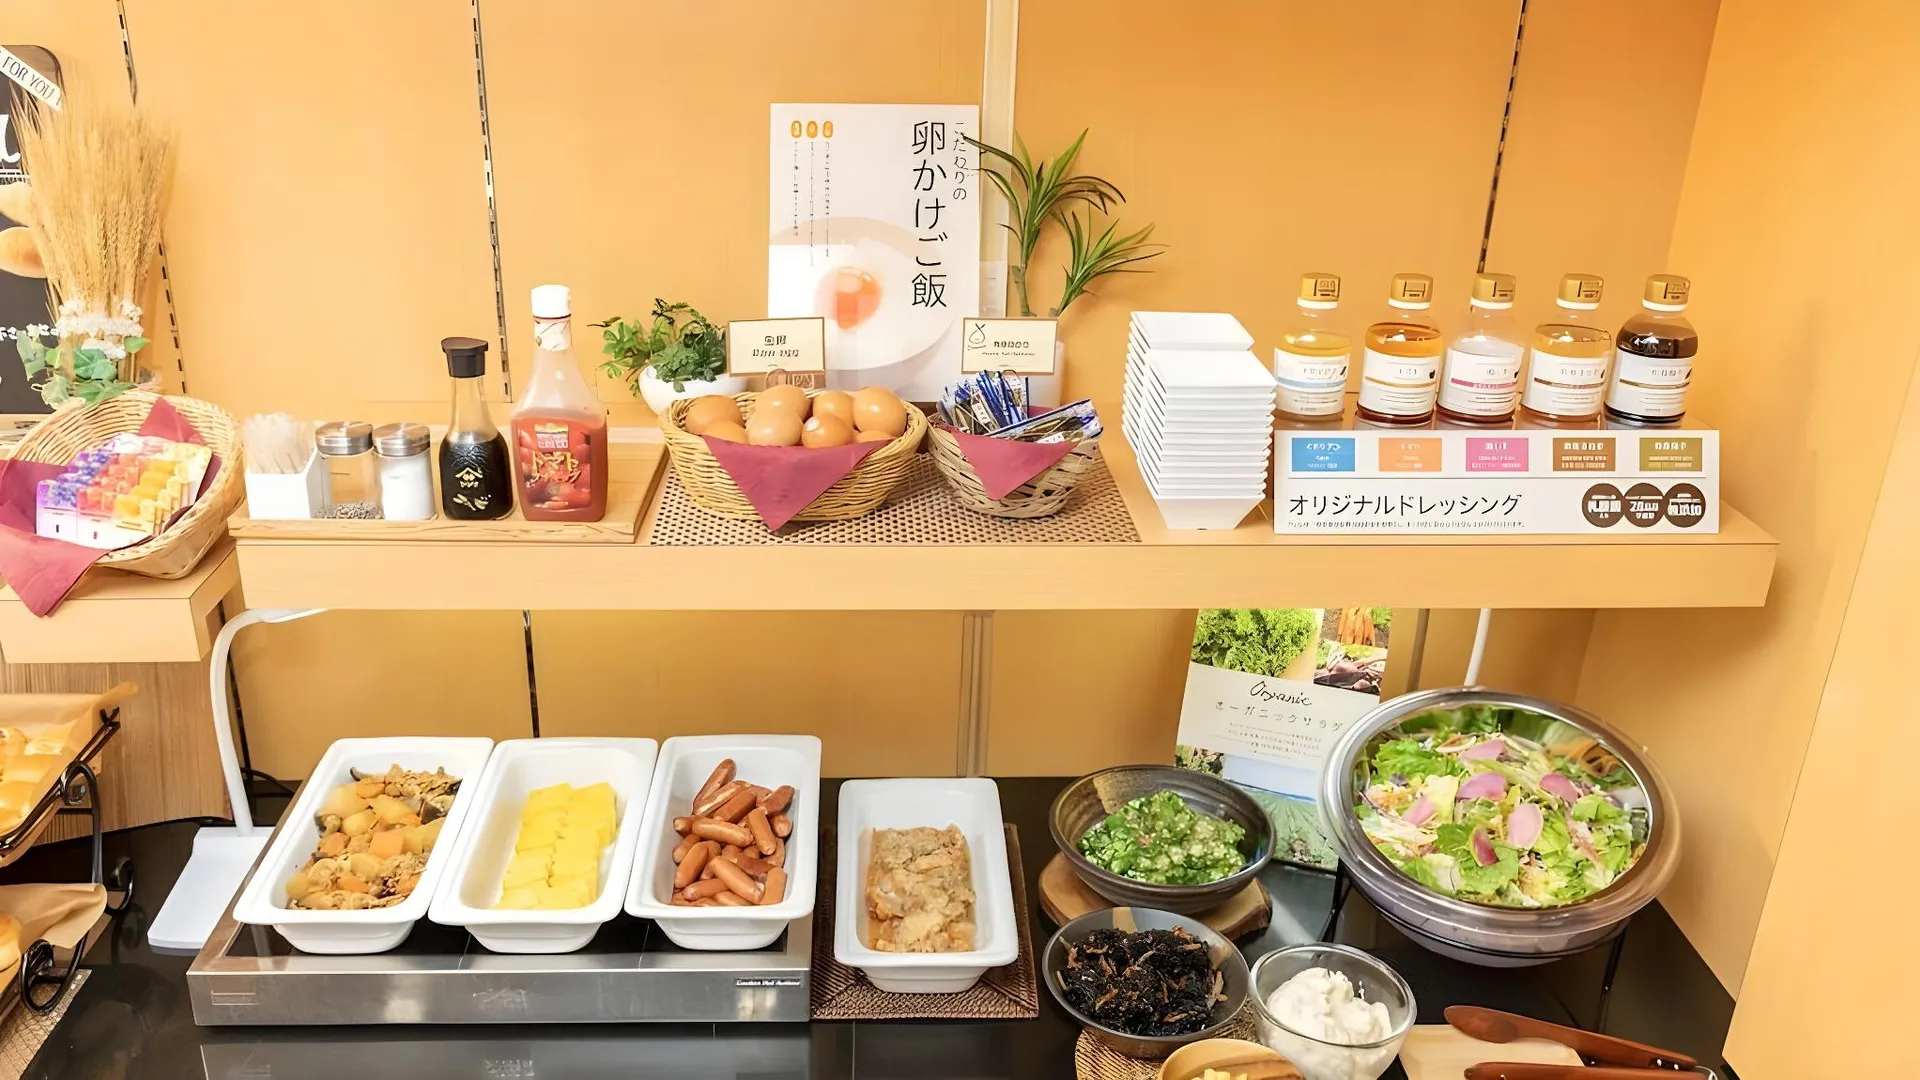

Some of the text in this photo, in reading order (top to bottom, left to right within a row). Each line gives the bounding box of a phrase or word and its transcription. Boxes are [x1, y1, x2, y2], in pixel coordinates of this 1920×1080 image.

[2, 56, 28, 81] FOR
[30, 74, 55, 100] YOU
[911, 120, 948, 308] 卵かけご飯
[1289, 494, 1522, 516] オリジナルドレッシング
[1250, 681, 1312, 706] Organic
